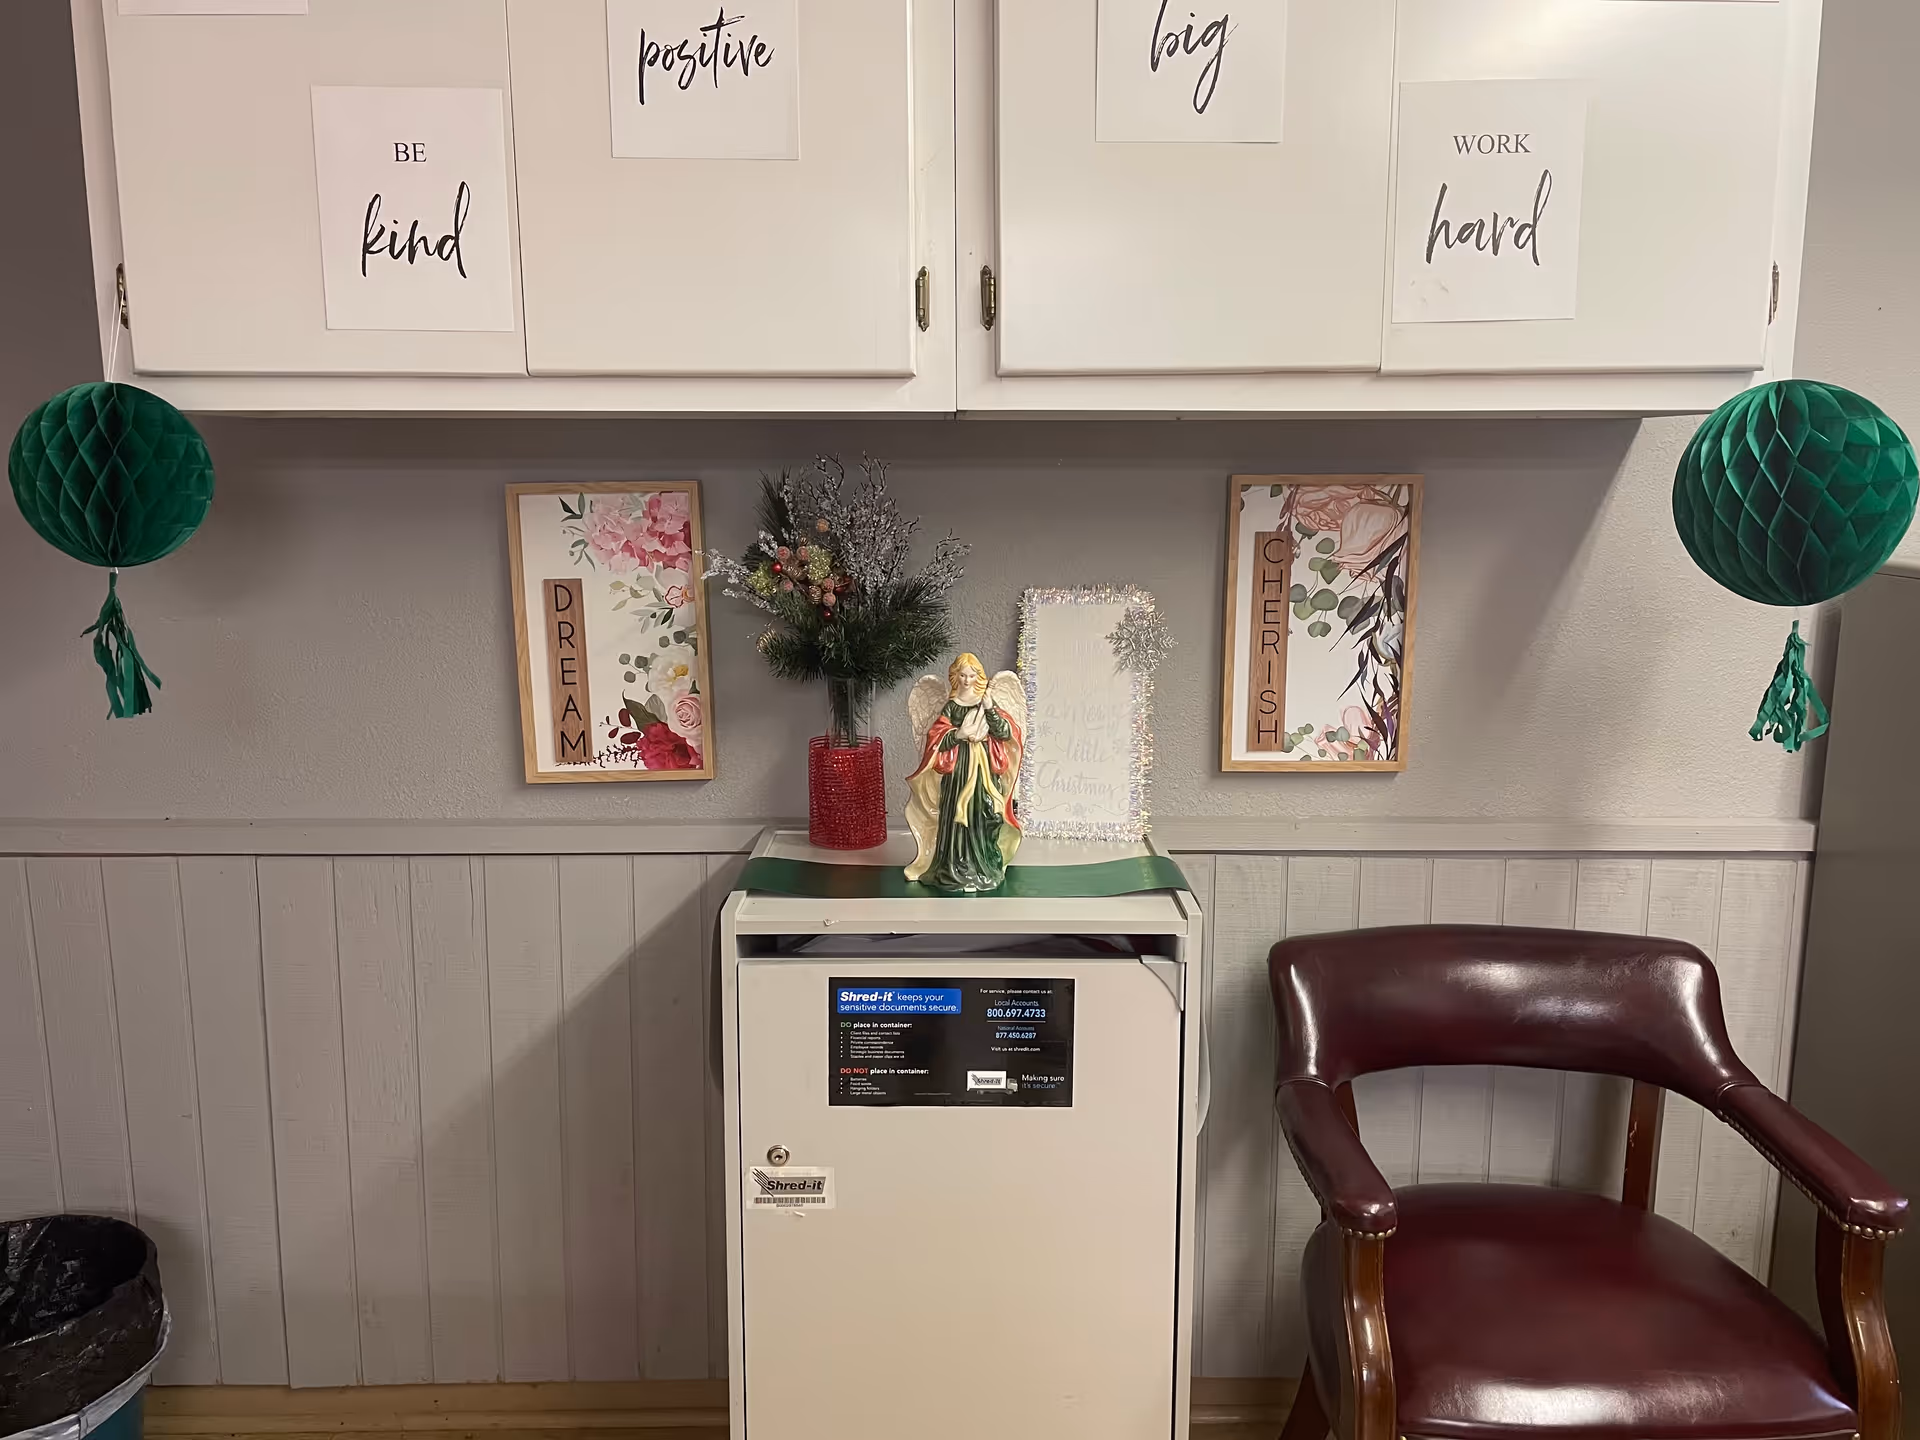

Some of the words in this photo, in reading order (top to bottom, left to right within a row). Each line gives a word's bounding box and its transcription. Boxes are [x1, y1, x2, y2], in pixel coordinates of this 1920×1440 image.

[638, 6, 775, 106] positive
[1150, 0, 1239, 114] big
[393, 142, 428, 163] BE
[1453, 133, 1532, 155] WORK
[1425, 168, 1553, 267] hard
[361, 180, 471, 279] kind
[1257, 537, 1285, 745] CHERISH
[554, 583, 588, 759] DREAM
[840, 991, 893, 1001] Shred-it
[897, 993, 923, 1003] keeps
[925, 994, 944, 1003] your
[840, 1003, 876, 1012] sensitive
[878, 1003, 927, 1012] documents
[928, 1004, 959, 1012] secure.
[986, 1008, 1046, 1018] 800.697.4733
[1021, 1074, 1048, 1083] Making
[767, 1180, 823, 1190] Shred-it
